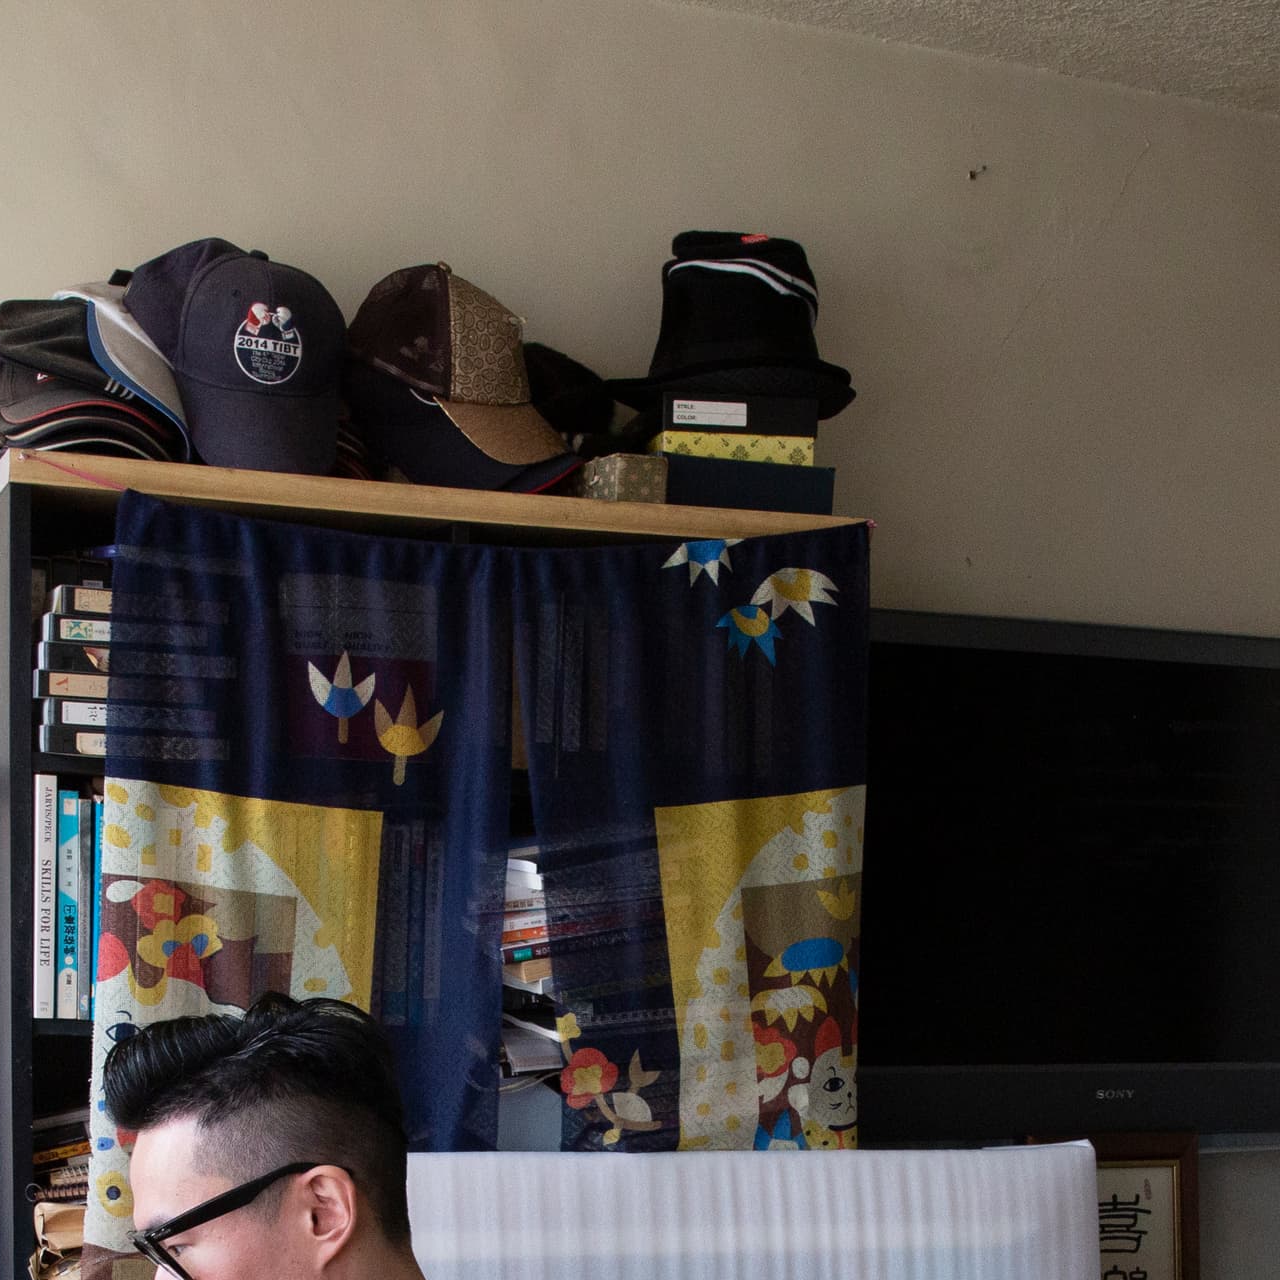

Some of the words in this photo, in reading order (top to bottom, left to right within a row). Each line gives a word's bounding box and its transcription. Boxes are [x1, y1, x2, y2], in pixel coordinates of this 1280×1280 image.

[238, 336, 269, 349] 2014
[271, 341, 299, 355] TIBT
[43, 786, 53, 843] JARVIS/PECK
[41, 858, 53, 904] SKILLS
[40, 906, 51, 934] FOR
[39, 936, 51, 967] LIFE
[1095, 1089, 1135, 1100] SONY
